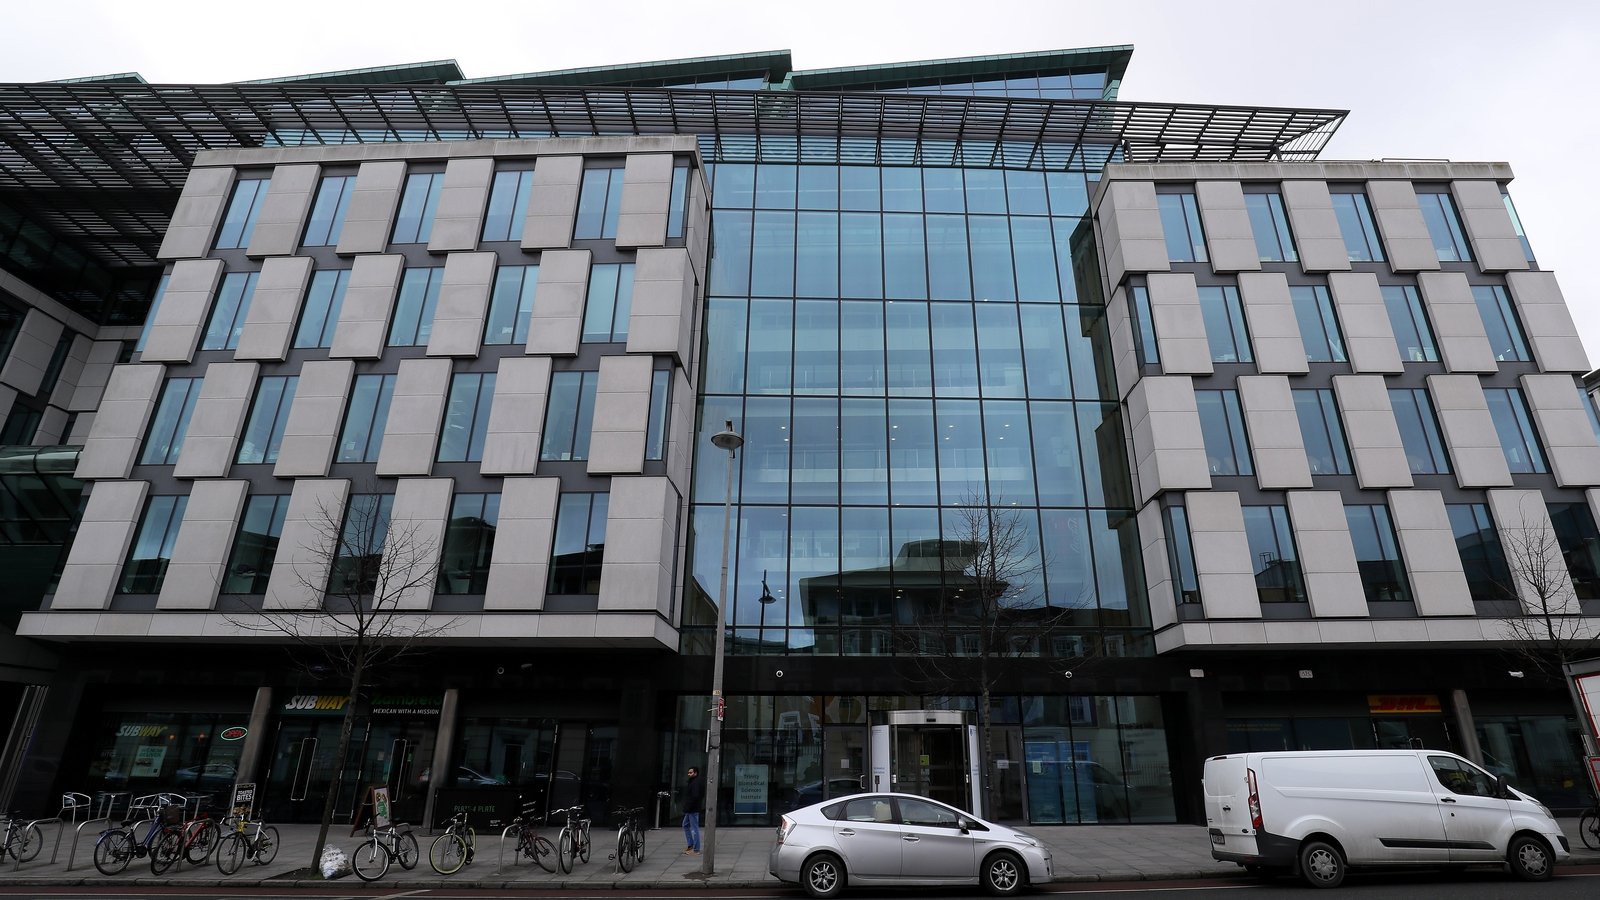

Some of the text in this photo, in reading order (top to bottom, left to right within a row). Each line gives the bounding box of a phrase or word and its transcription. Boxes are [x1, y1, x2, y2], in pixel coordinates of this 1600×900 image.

[285, 695, 350, 710] SUBWAY
[370, 692, 442, 705] Zambrero
[115, 725, 168, 737] SUBWAY
